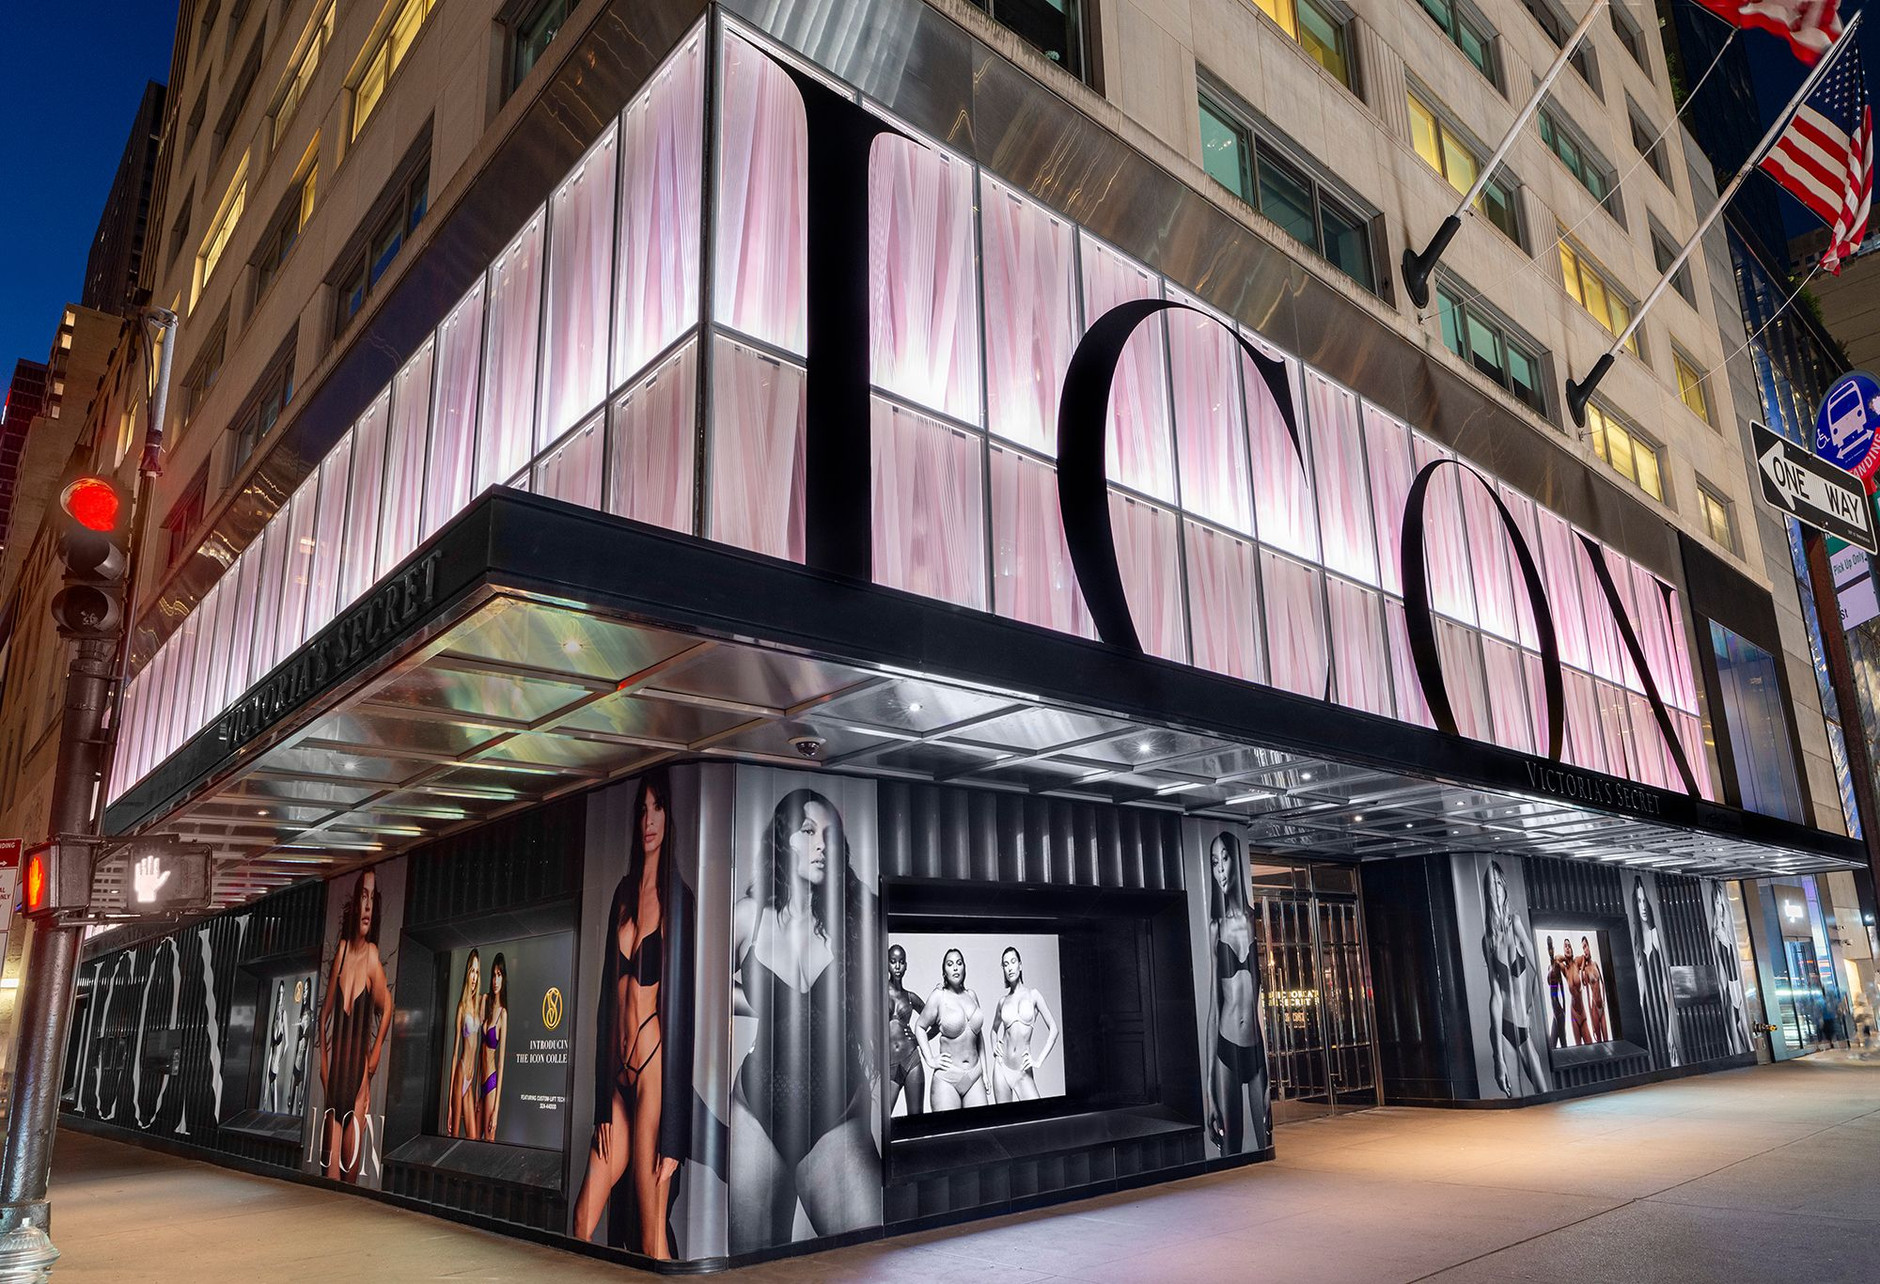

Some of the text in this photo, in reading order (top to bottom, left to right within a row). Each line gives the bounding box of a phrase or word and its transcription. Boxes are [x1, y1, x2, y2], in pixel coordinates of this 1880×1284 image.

[727, 28, 1702, 799] ICON
[1773, 456, 1860, 525] ONE WAY
[335, 549, 442, 668] SECRET
[1524, 760, 1661, 815] VICTORIA'S SECRET
[516, 1053, 529, 1063] THE
[529, 1053, 545, 1064] ICON
[306, 1105, 386, 1180] ICON
